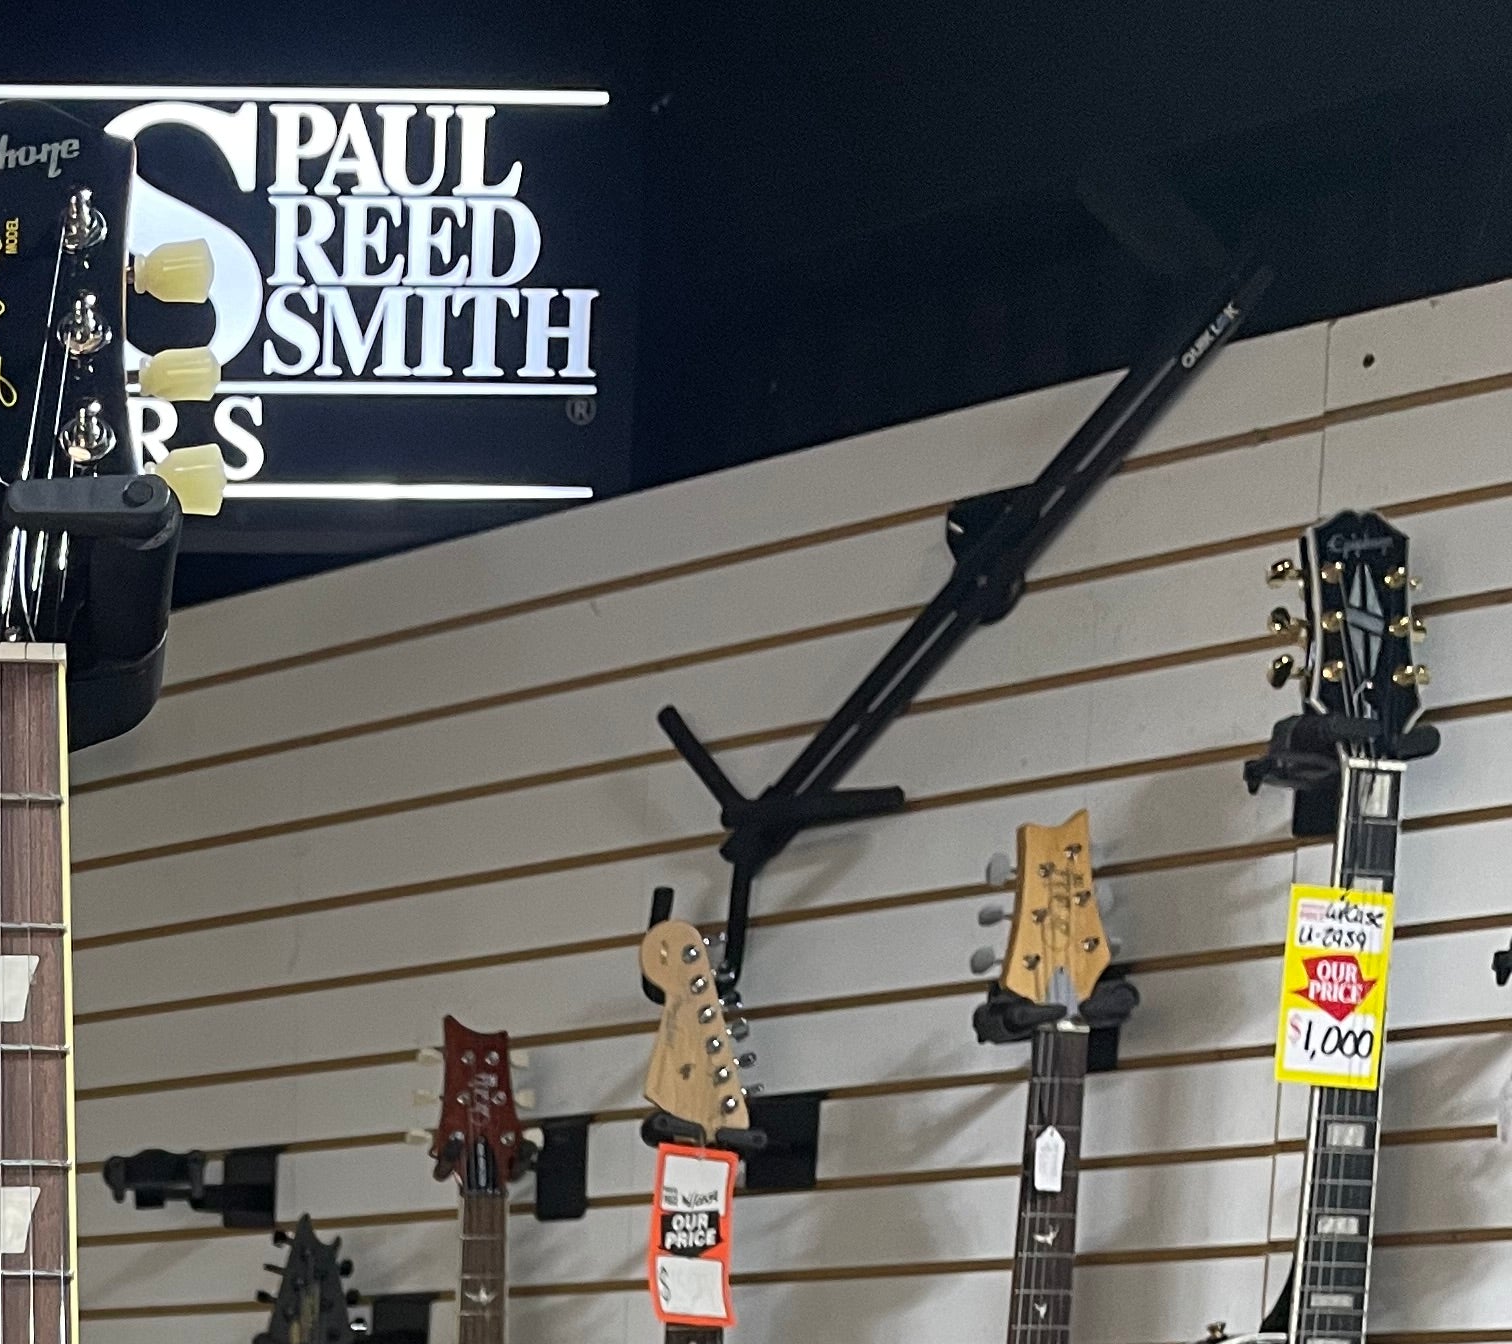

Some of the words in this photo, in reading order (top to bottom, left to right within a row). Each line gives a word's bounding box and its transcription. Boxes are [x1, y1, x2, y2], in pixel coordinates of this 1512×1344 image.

[266, 102, 523, 196] PAUL
[5, 217, 20, 255] MODEL
[265, 194, 542, 287] REED
[263, 283, 601, 378] SMITH
[1316, 959, 1358, 982] OUR
[1308, 979, 1363, 1004] PRICE
[671, 1212, 709, 1232] OUR
[664, 1228, 717, 1250] PRICE
